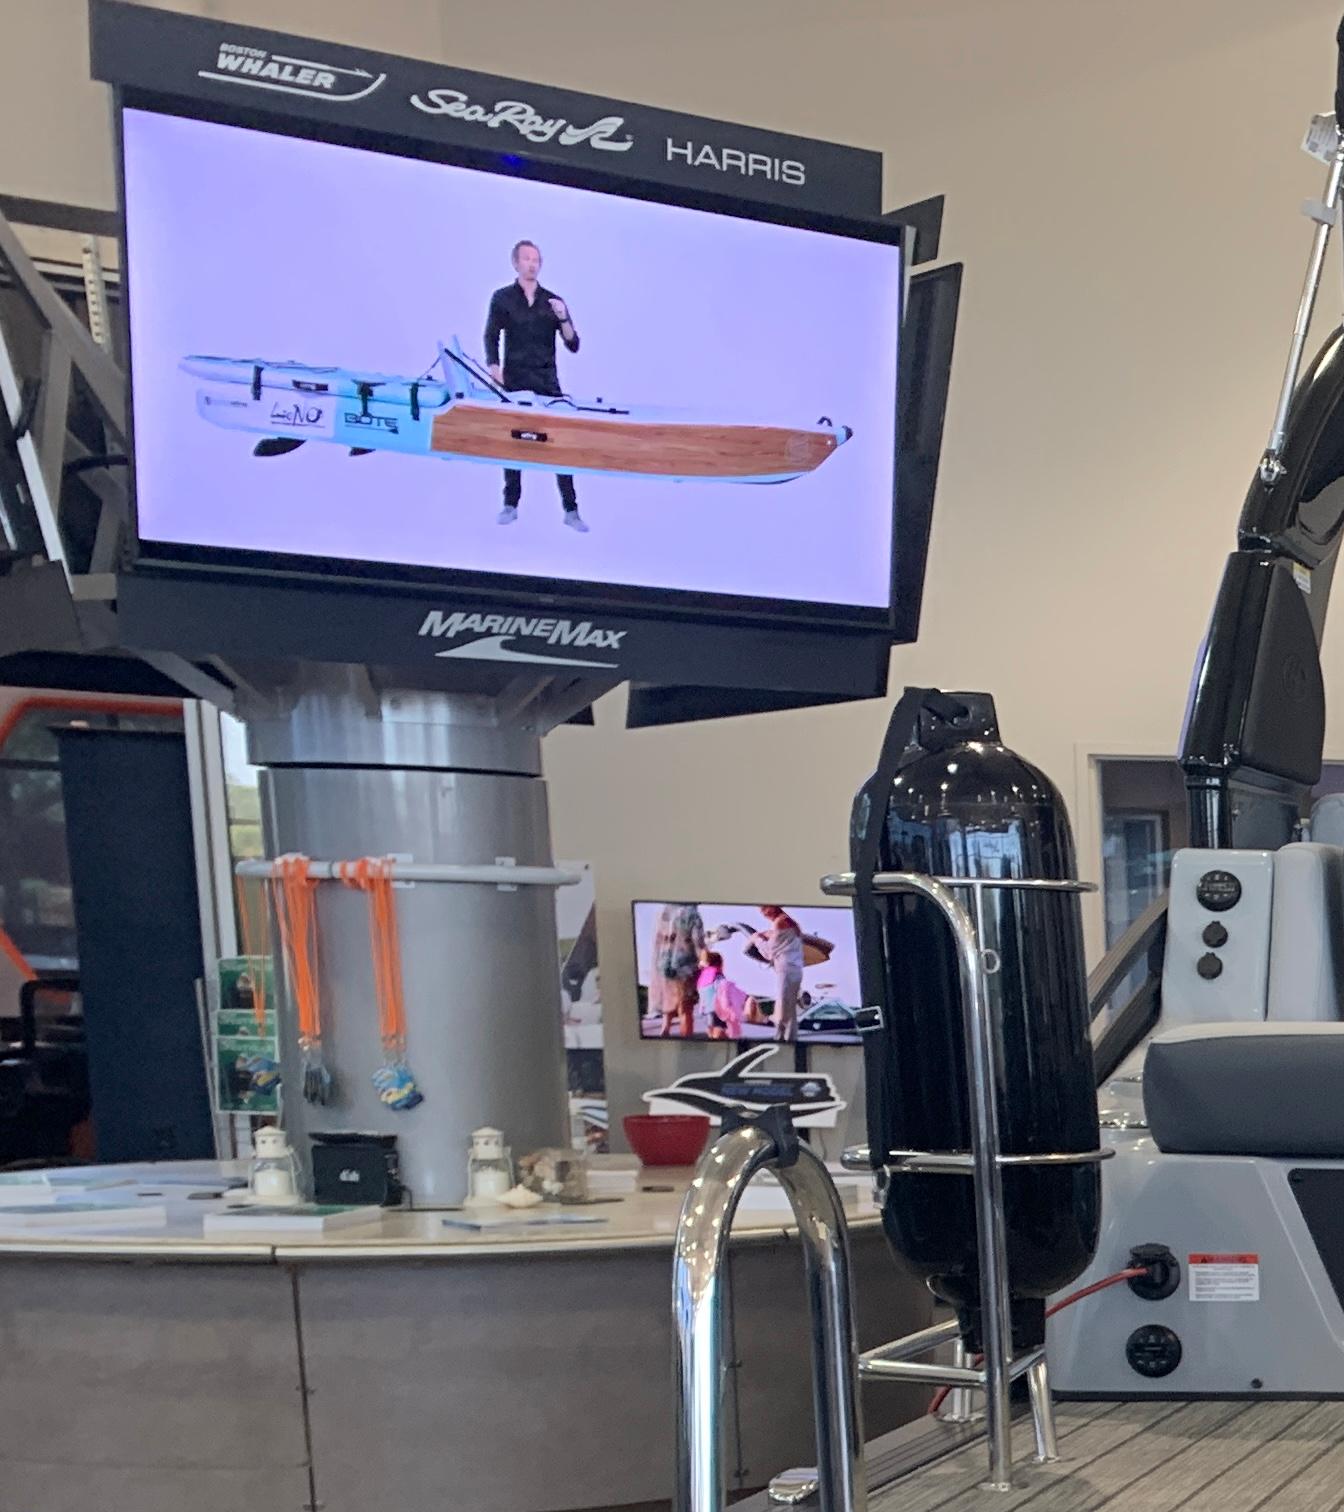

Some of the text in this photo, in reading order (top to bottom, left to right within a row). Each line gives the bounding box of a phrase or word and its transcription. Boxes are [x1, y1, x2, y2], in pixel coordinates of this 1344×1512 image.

[219, 43, 268, 58] BOSTON
[217, 53, 336, 89] WHALER
[666, 138, 806, 185] HARRIS
